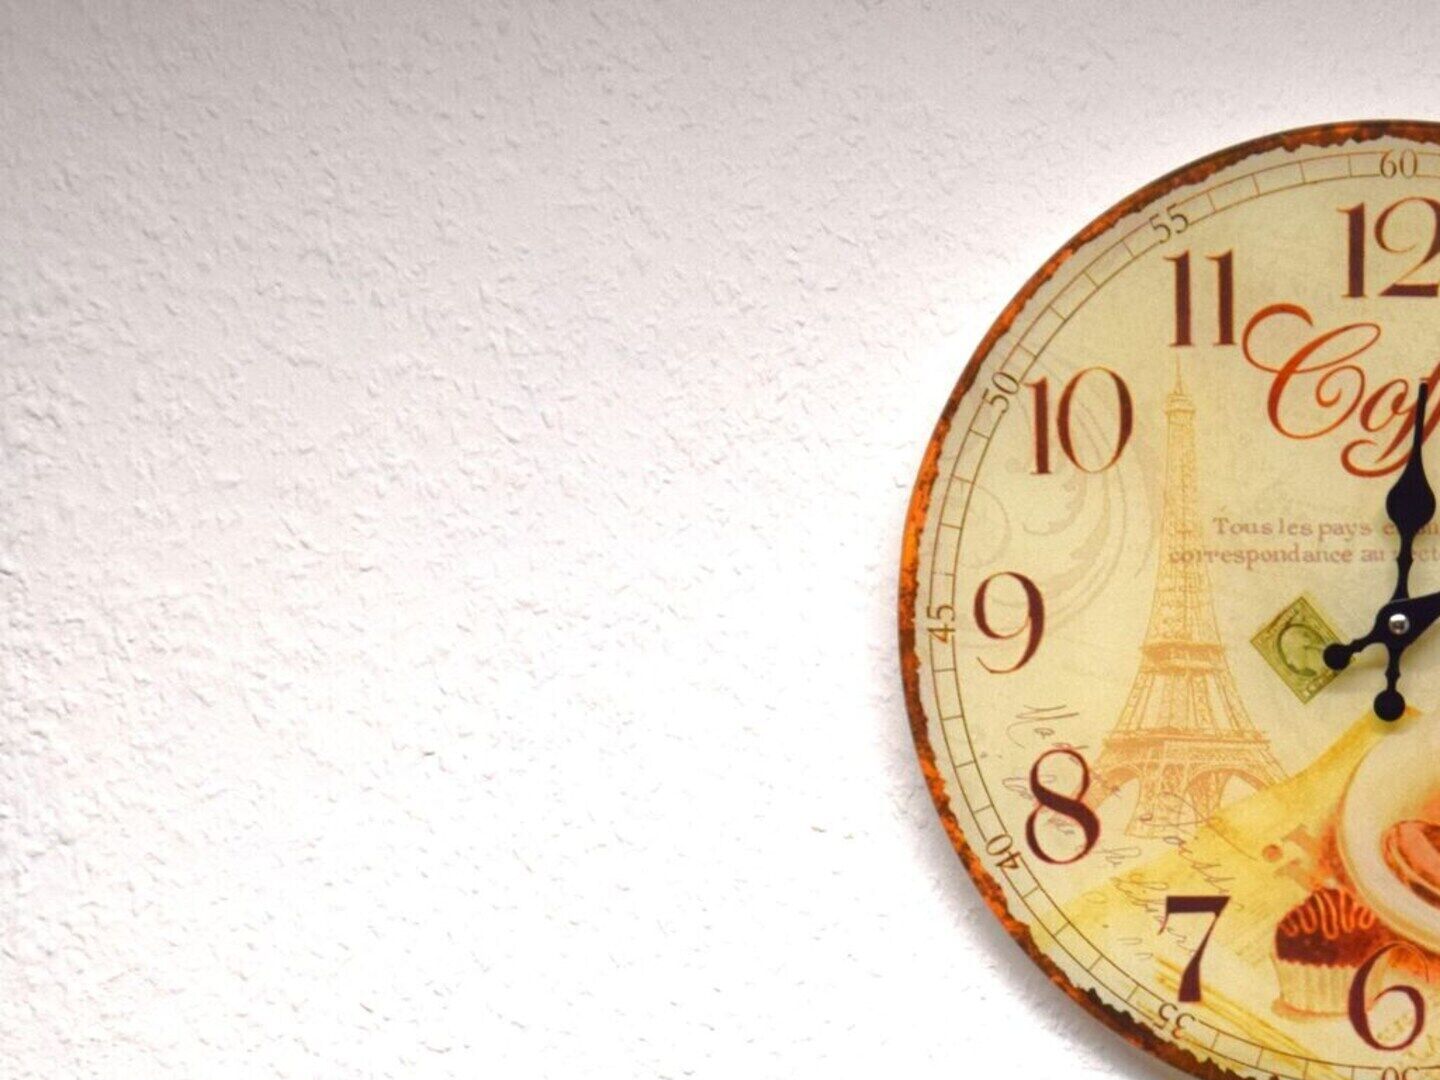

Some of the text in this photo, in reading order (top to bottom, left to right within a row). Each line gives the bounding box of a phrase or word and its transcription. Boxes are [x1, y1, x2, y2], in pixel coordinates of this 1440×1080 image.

[1379, 149, 1418, 178] 60
[1149, 203, 1190, 243] 55
[1163, 249, 1238, 347] 11
[981, 371, 1021, 414] 50
[1024, 367, 1133, 475] 10
[1213, 516, 1274, 536] Tous
[1280, 517, 1314, 536] les
[1318, 521, 1373, 542] pays
[1169, 544, 1350, 570] correspondance
[926, 605, 956, 644] 45
[973, 571, 1045, 674] 9
[1025, 748, 1101, 865] 8
[985, 833, 1021, 870] 40
[1157, 896, 1231, 1004] 7
[1348, 942, 1429, 1051] 6
[1153, 1002, 1196, 1040] 35
